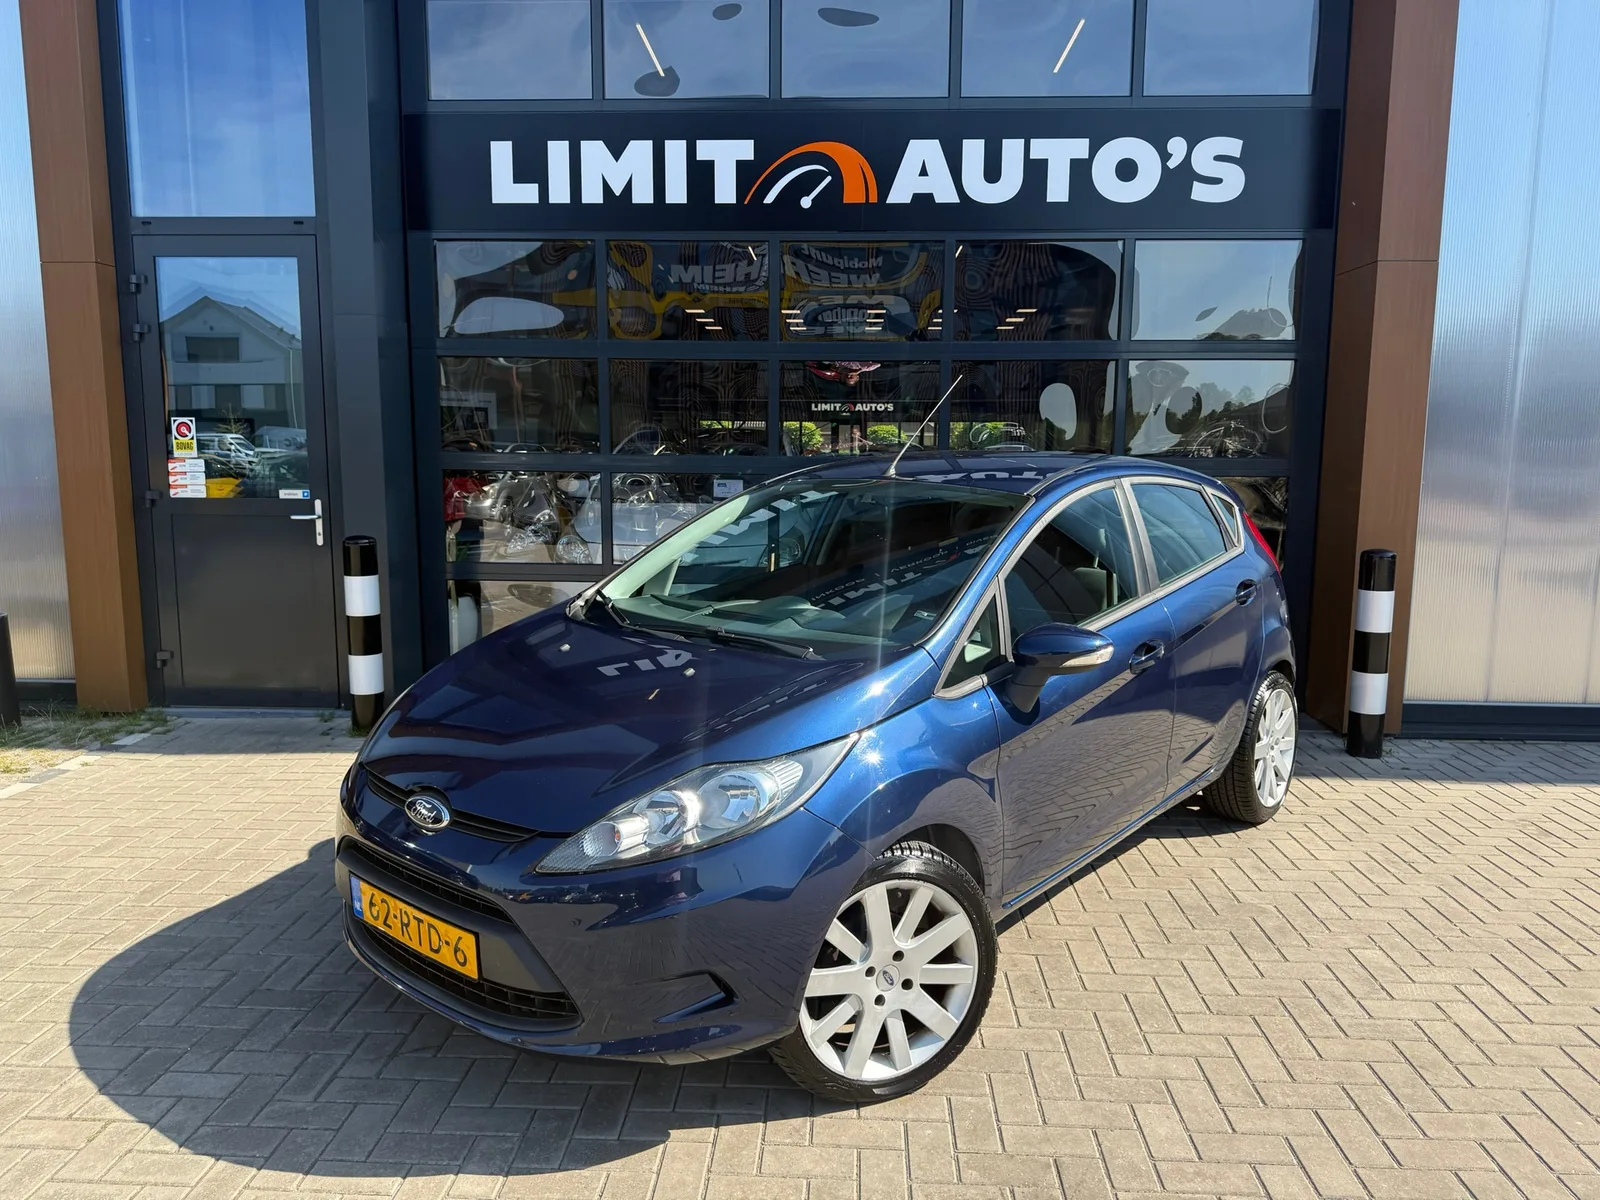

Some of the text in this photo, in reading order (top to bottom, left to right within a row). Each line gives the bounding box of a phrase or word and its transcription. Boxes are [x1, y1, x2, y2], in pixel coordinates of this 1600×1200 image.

[490, 136, 1246, 205] LIMIT AUTO'S
[811, 402, 895, 412] LIMIT AUTO'S
[175, 441, 194, 451] BOVAG
[410, 800, 435, 824] Ford
[368, 892, 468, 968] 62-RTD-6
